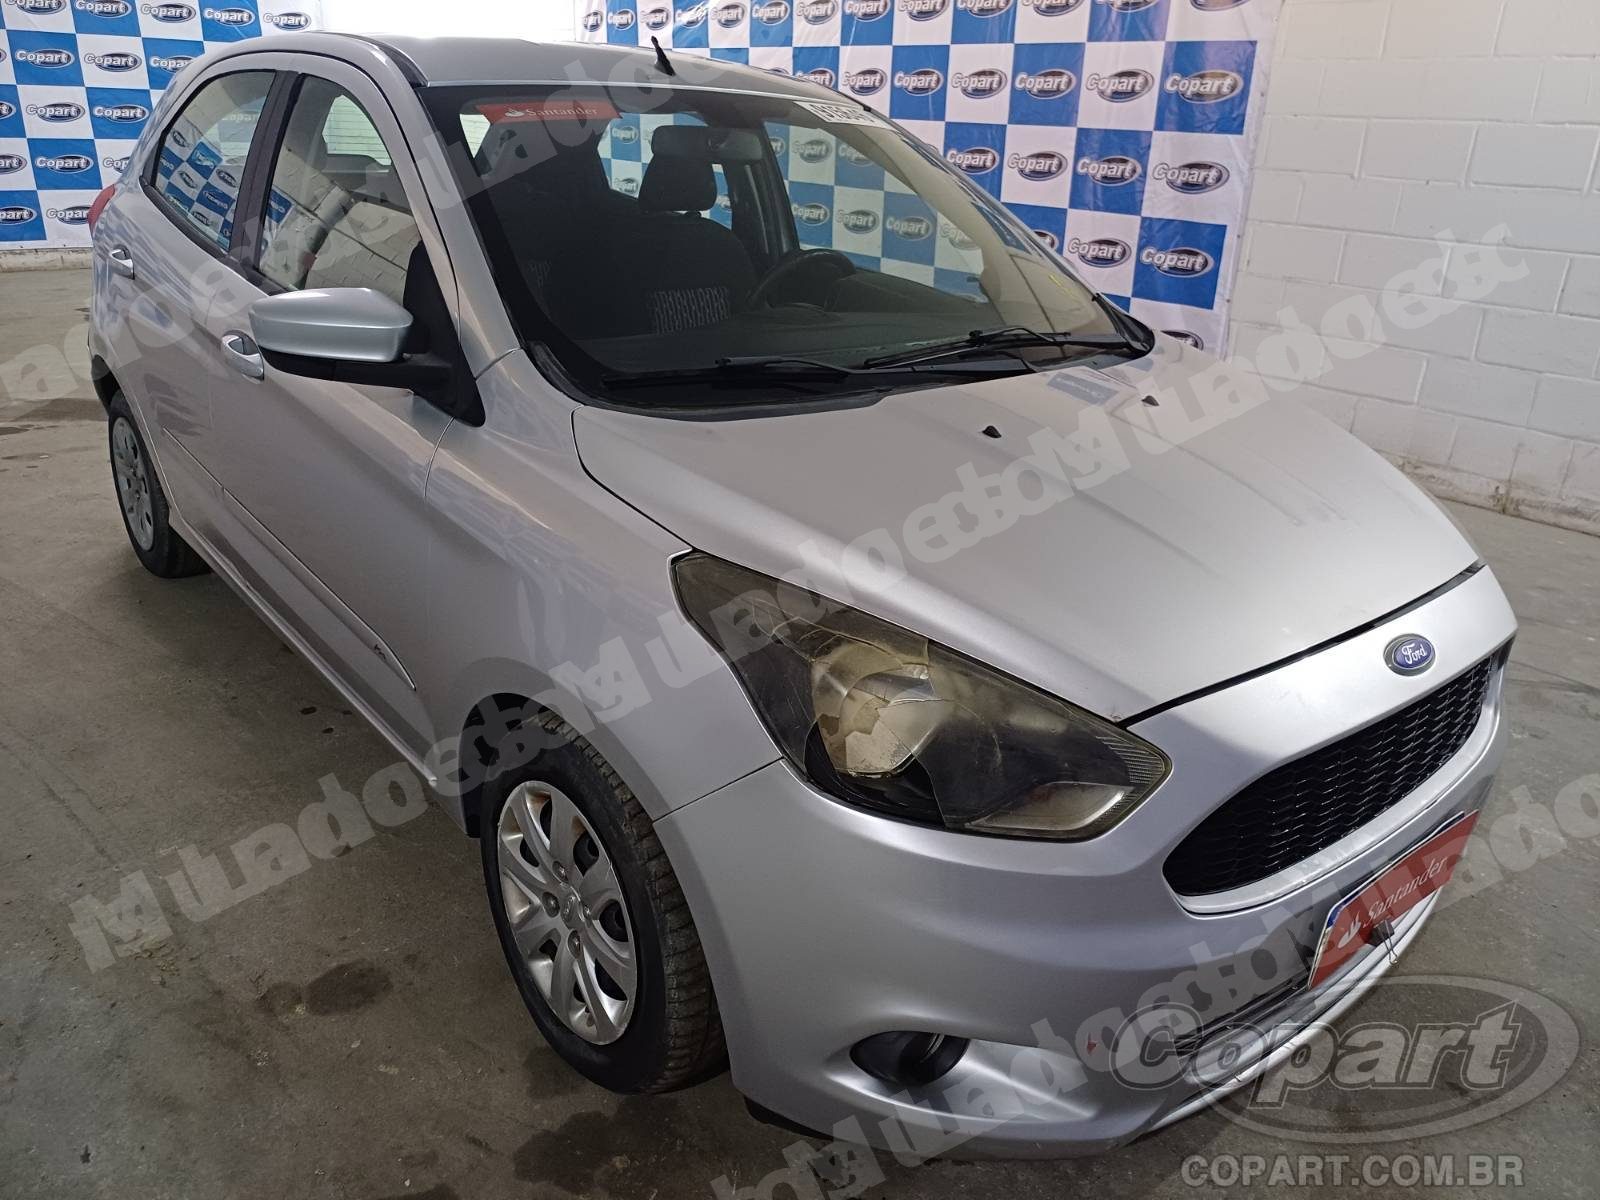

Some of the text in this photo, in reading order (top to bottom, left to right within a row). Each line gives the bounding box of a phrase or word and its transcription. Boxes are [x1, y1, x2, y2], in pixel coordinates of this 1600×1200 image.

[75, 0, 126, 15] Copart
[140, 4, 189, 19] Copart
[203, 8, 250, 23] Copart
[752, 4, 788, 20] Copart
[797, 2, 832, 17] Copart
[844, 0, 884, 16] Copart
[899, 0, 942, 15] Copart
[263, 13, 306, 27] Copart
[16, 50, 68, 65] Copart
[84, 53, 135, 69] Copart
[842, 72, 881, 90] Copart
[894, 71, 938, 90] Copart
[952, 72, 999, 92] Copart
[1014, 72, 1070, 92] Copart
[1086, 73, 1143, 96] Copart
[1165, 74, 1233, 97] Copart
[26, 104, 78, 121] Copart
[94, 106, 142, 122] Copart
[525, 107, 598, 118] Santander
[36, 156, 88, 172] Copart
[946, 149, 993, 171] Copart
[1007, 152, 1060, 177] Copart
[1077, 157, 1133, 180] Copart
[1153, 163, 1218, 189] Copart
[837, 209, 875, 229] Copart
[886, 216, 928, 237] Copart
[1068, 237, 1124, 262] Copart
[1140, 247, 1204, 273] Copart
[1401, 643, 1428, 665] Ford
[1364, 857, 1448, 924] Santander
